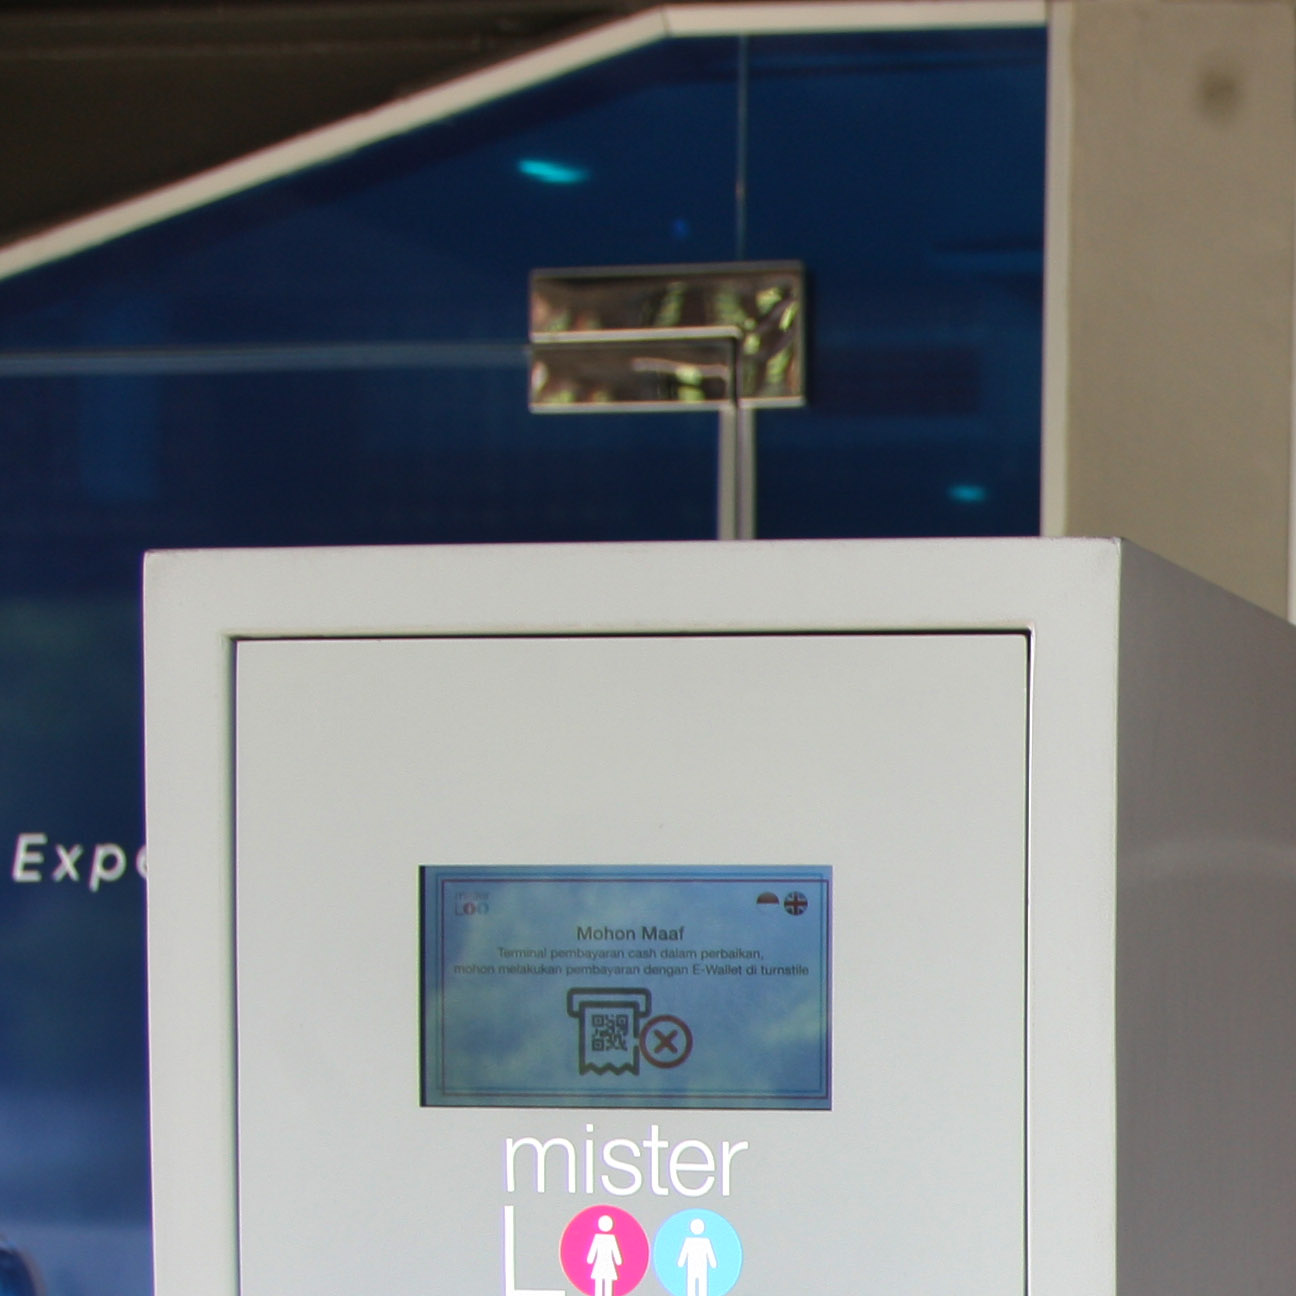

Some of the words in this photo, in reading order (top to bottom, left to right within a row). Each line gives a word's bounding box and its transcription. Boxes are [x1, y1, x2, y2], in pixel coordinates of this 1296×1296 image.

[576, 925, 636, 941] Mohon
[641, 924, 685, 941] Maaf
[498, 947, 547, 959] Terminal
[550, 947, 625, 960] pembayaran
[628, 948, 657, 959] cash
[660, 948, 697, 959] dalam
[700, 948, 764, 961] perbaikan,
[453, 964, 495, 975] mohon
[498, 964, 562, 975] melakukan
[566, 964, 640, 977] pembayaran
[643, 965, 689, 977] dengan
[692, 965, 742, 976] E-Wallet
[746, 965, 757, 976] di
[760, 965, 809, 976] turnstile
[504, 1124, 749, 1195] mister
